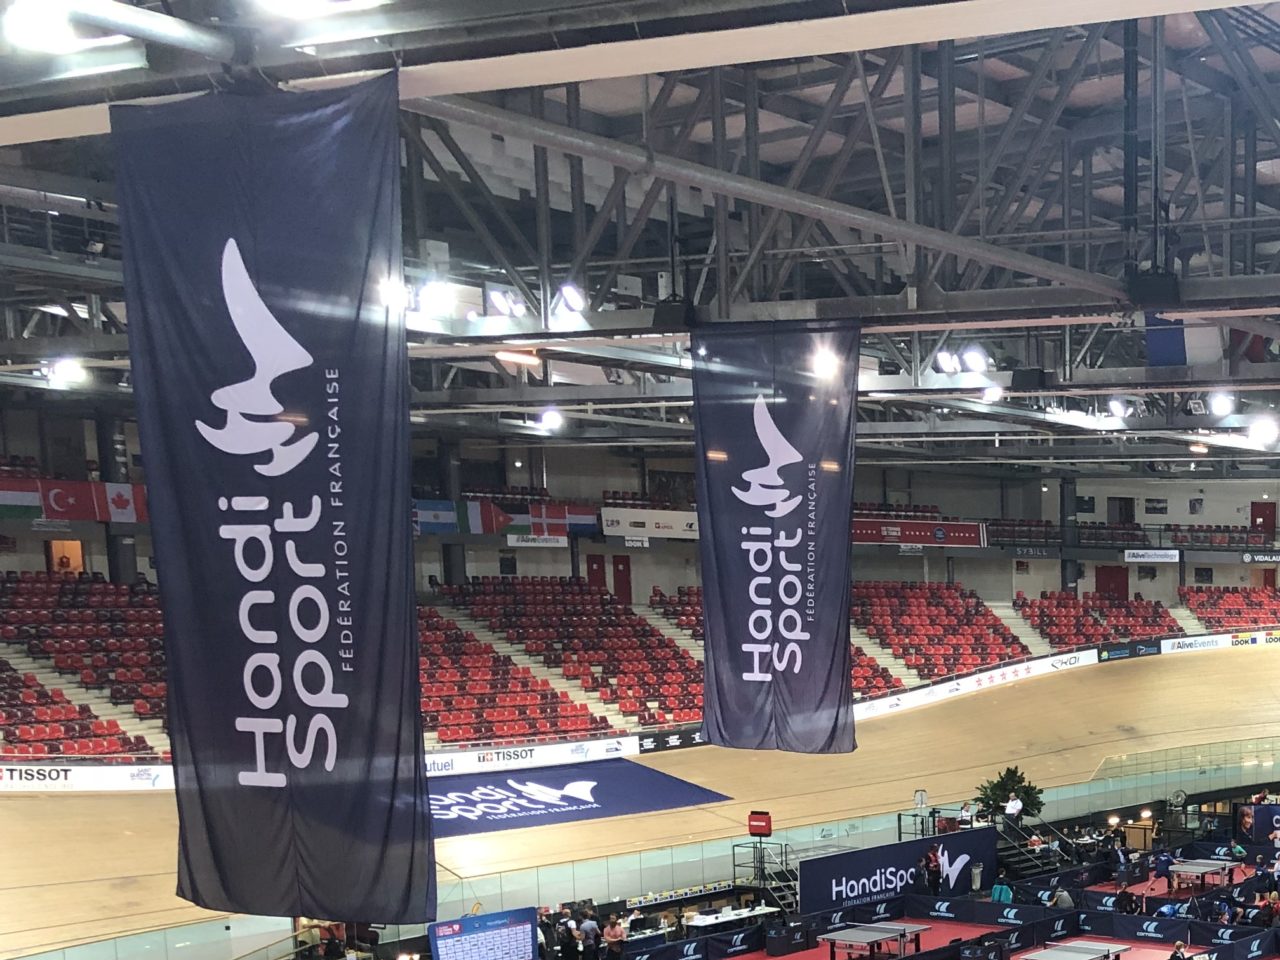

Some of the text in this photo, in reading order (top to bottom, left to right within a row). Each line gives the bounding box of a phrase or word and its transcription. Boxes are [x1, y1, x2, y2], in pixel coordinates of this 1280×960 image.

[325, 367, 354, 672] FÉDÉRATION FRANÇAISE
[806, 462, 817, 622] FÉDÉRATION FRANÇAISE
[740, 526, 772, 682] Handi
[218, 495, 287, 788] Handi
[425, 758, 454, 772] utuel
[494, 748, 535, 762] TISSOT
[5, 768, 72, 781] TISSOT
[429, 784, 510, 807] andi
[831, 865, 916, 901] HandiSpo
